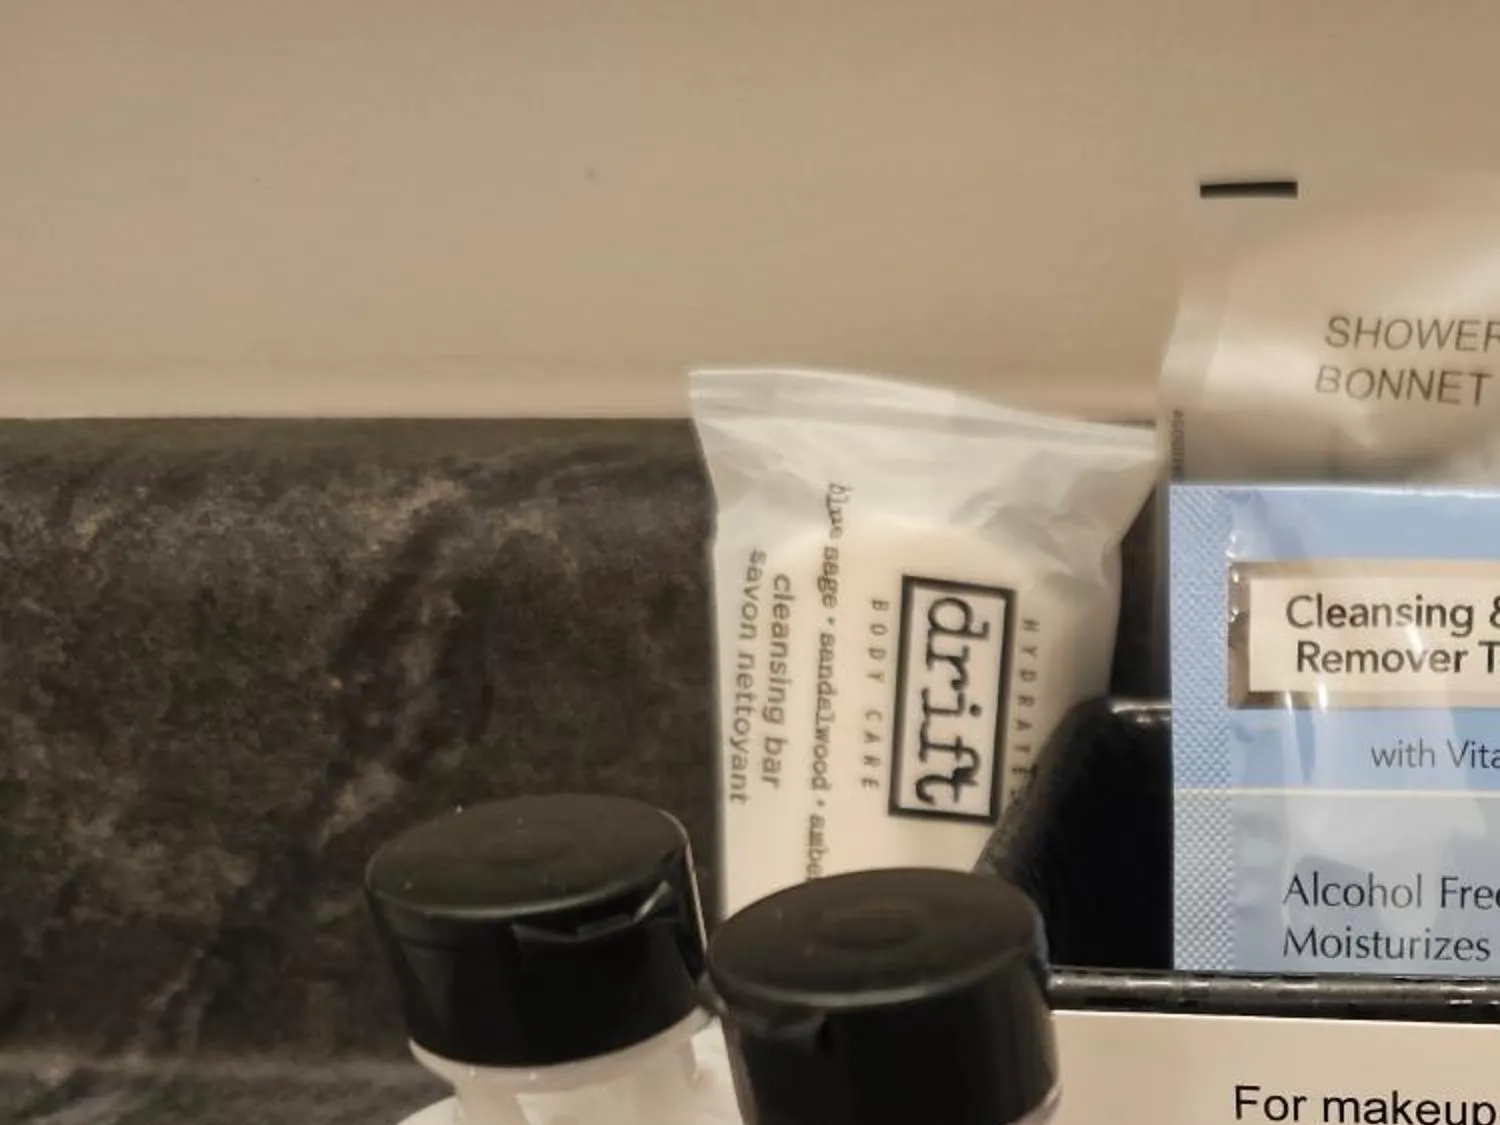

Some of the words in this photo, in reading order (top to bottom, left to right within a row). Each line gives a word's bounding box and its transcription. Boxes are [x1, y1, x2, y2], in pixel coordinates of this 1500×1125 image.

[1315, 364, 1488, 408] BONNET
[738, 548, 767, 640] savon
[817, 546, 839, 609] sage
[866, 599, 890, 684] BODY
[1286, 594, 1474, 638] Cleansing
[762, 573, 792, 723] cleansing
[1297, 640, 1468, 675] Remover
[727, 652, 760, 807] nettoyant
[810, 632, 838, 791] sandalwood
[914, 596, 989, 806] drift
[760, 730, 788, 790] bar
[861, 708, 883, 790] CARE
[1371, 740, 1436, 769] with
[806, 814, 829, 878] ambe
[1283, 873, 1423, 911] Alcohol
[1283, 925, 1491, 961] Moisturizes
[1235, 1085, 1308, 1121] For
